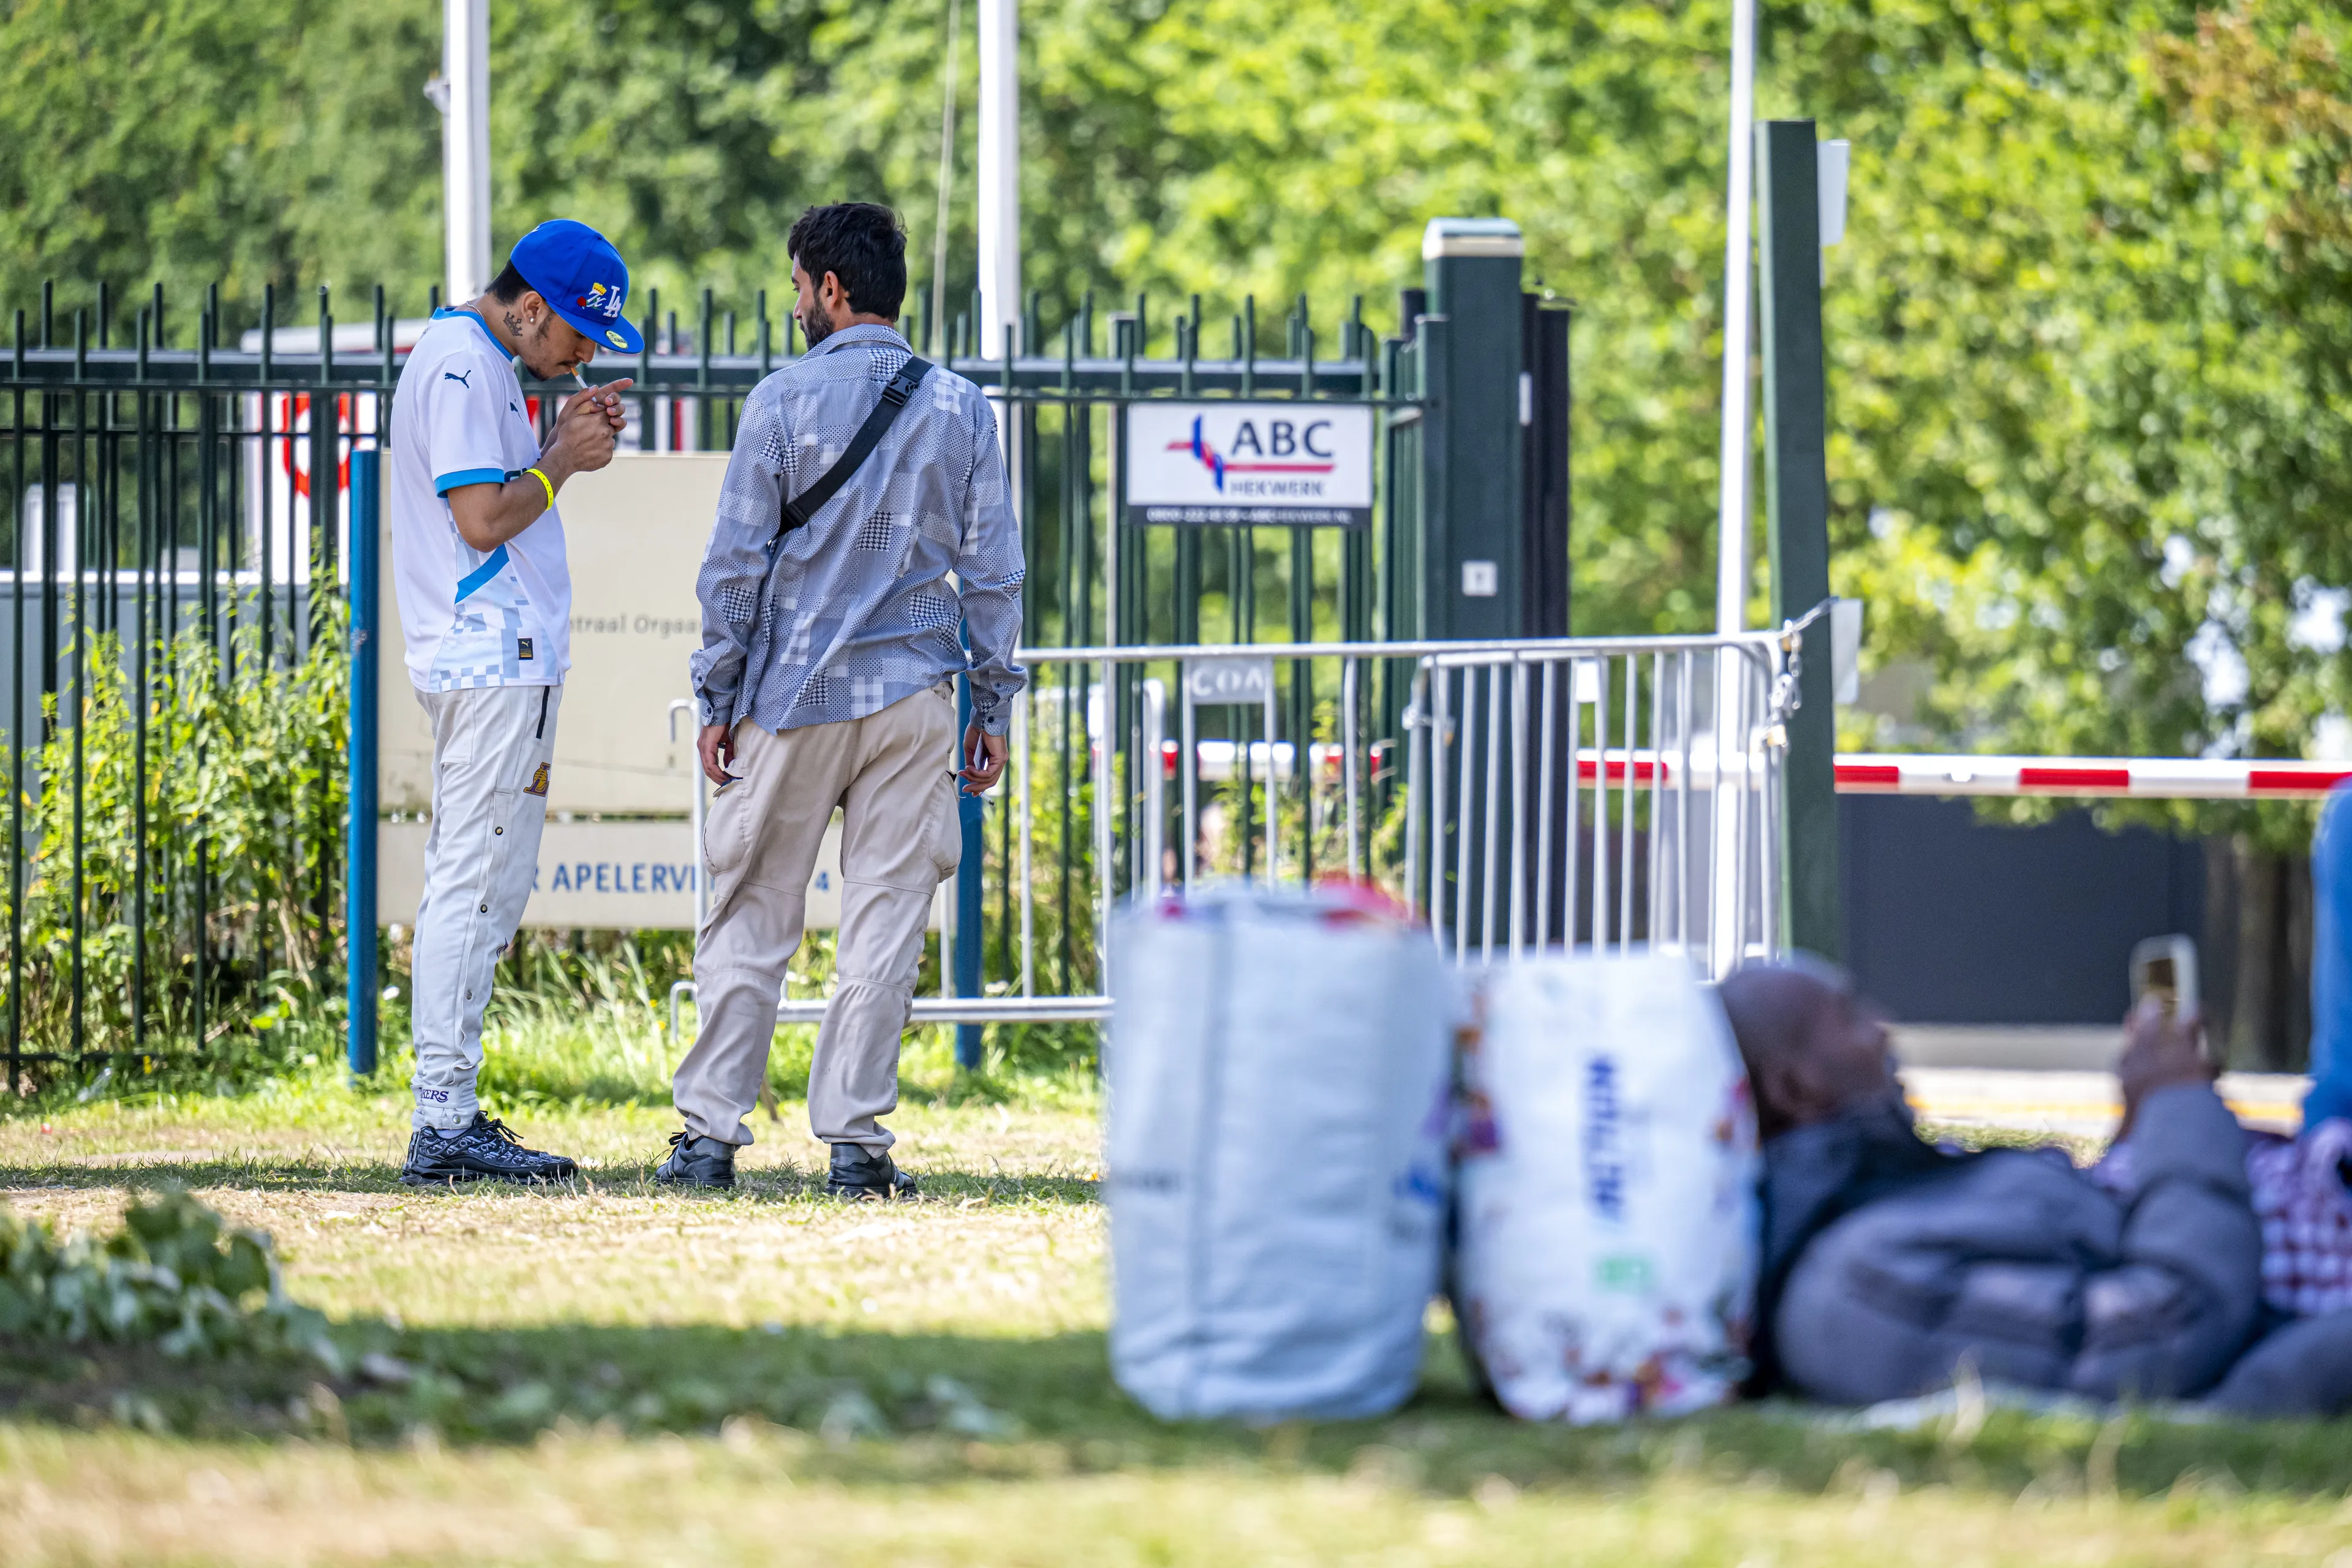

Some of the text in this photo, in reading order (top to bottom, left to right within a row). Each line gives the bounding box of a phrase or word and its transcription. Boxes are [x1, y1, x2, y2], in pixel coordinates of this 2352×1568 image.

[603, 285, 622, 318] LA
[1231, 420, 1333, 458] ABC
[1231, 480, 1325, 496] HEKWERK
[633, 614, 702, 639] Orgaa
[814, 871, 829, 892] 4
